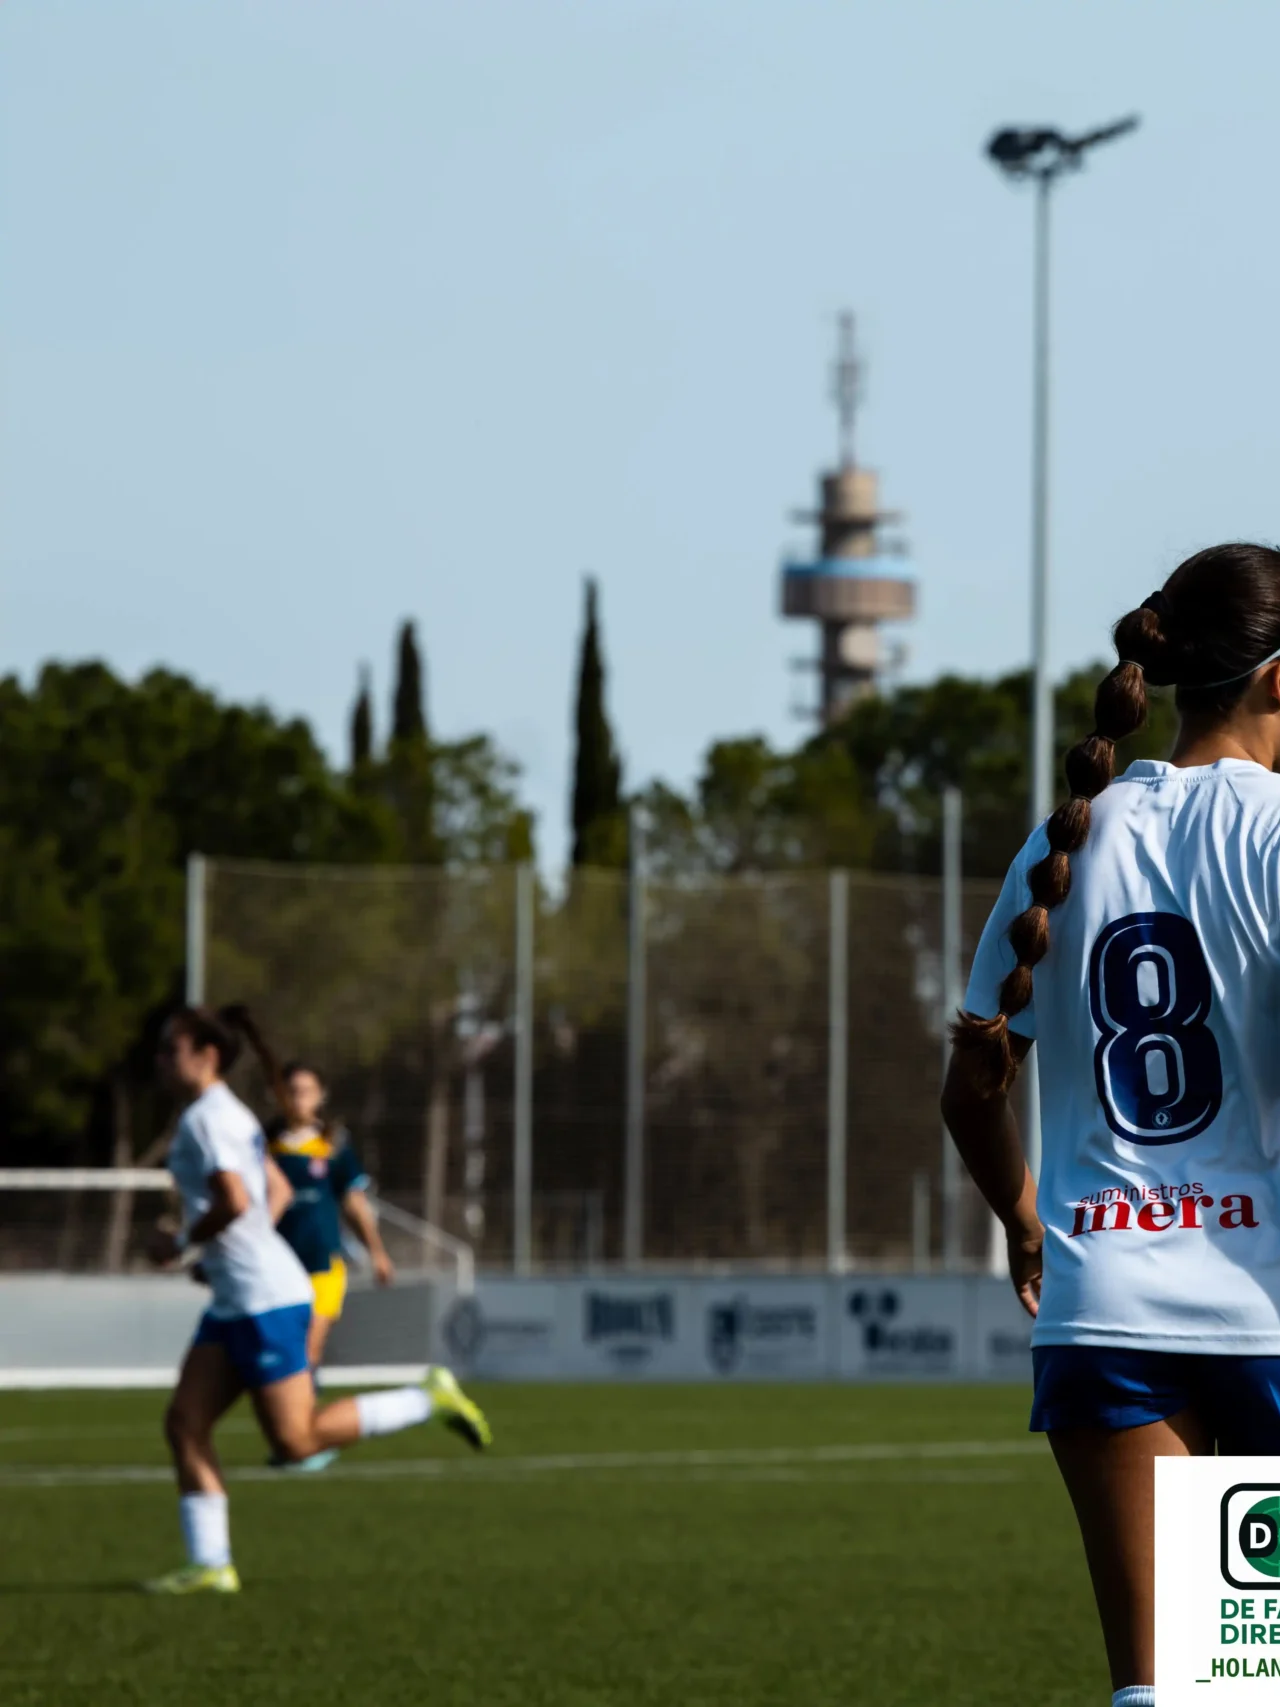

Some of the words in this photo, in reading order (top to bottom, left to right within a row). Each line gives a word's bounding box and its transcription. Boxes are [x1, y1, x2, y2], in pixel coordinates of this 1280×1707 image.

[1089, 912, 1223, 1146] 8
[1068, 1194, 1260, 1238] mera
[1078, 1182, 1204, 1207] suministros
